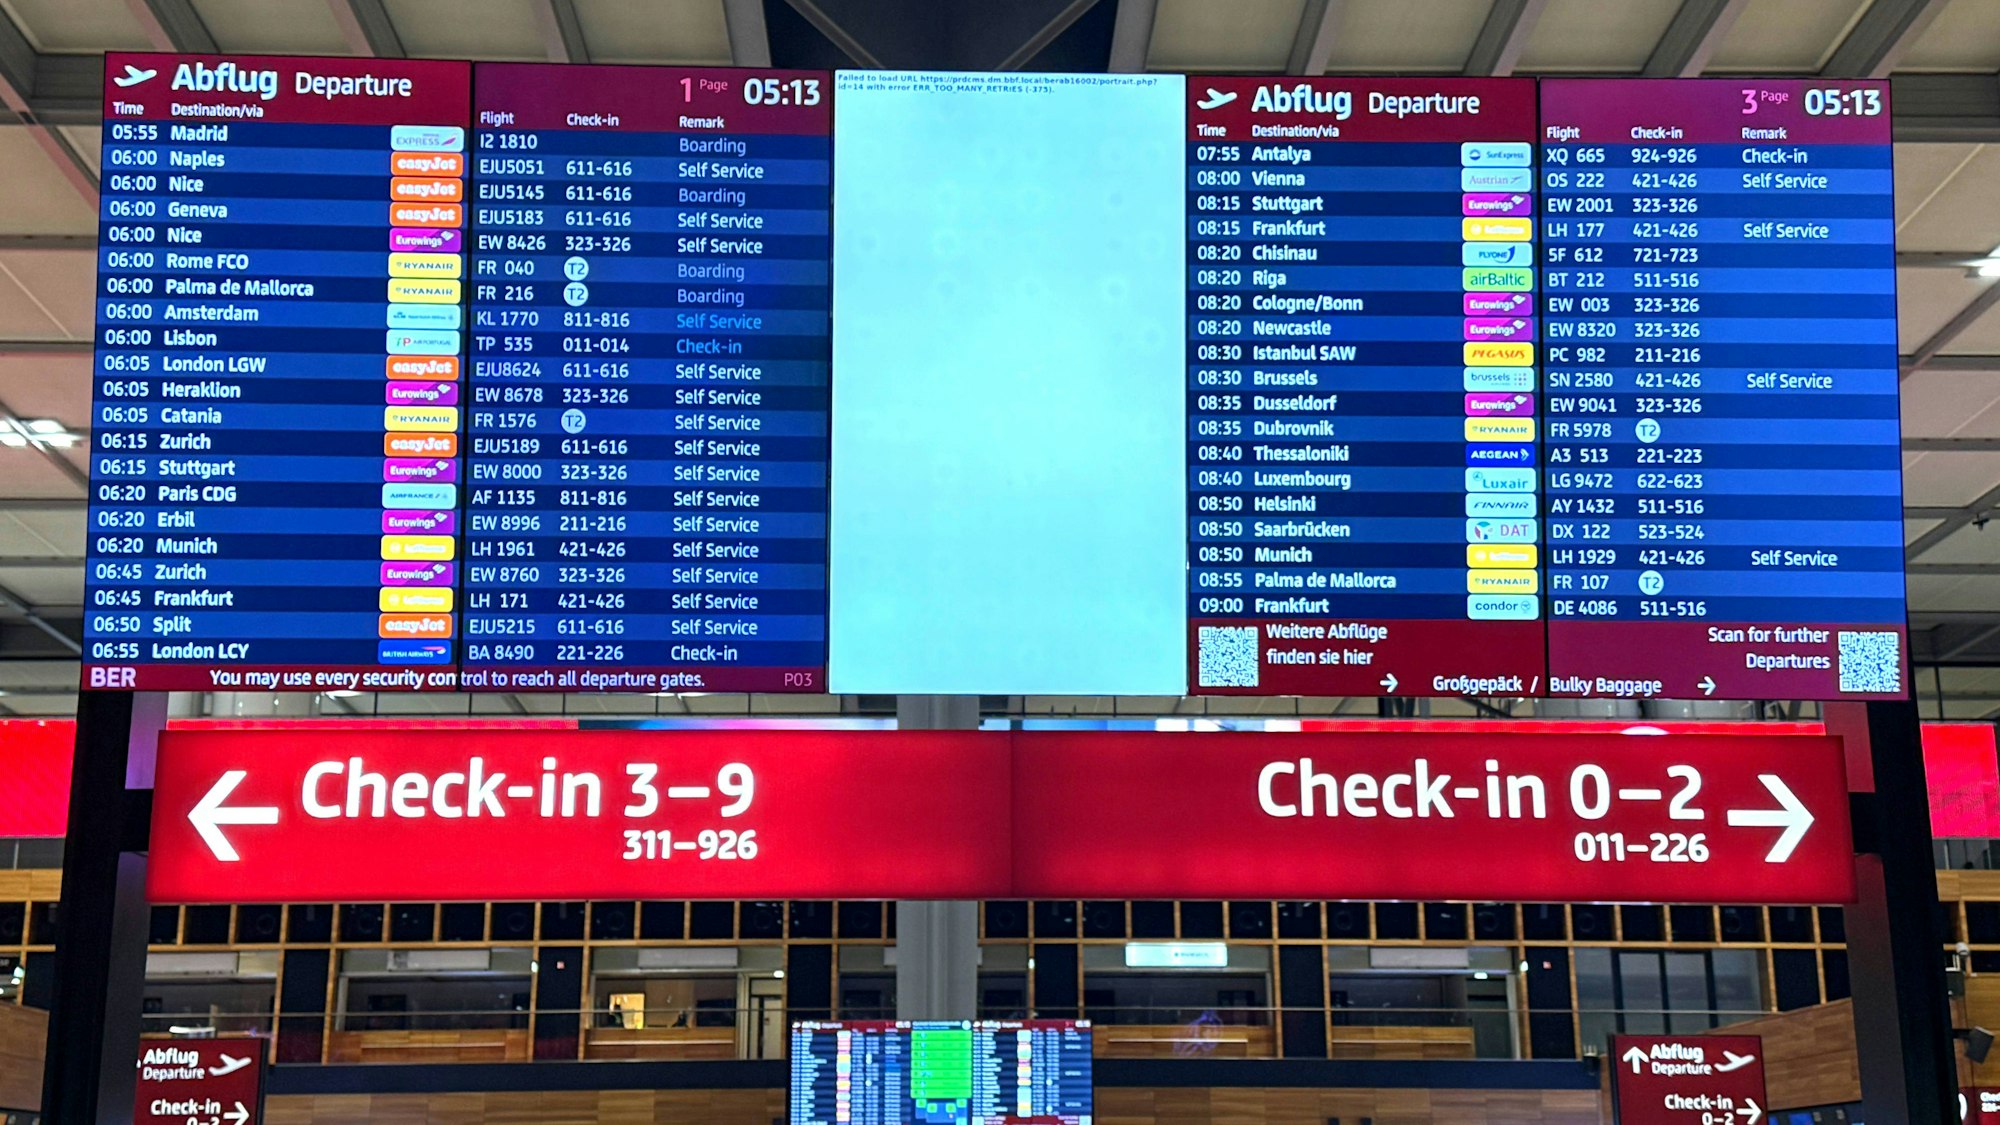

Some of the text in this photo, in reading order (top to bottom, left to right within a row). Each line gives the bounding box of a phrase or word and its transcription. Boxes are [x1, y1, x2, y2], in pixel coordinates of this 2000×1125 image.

[172, 62, 412, 100] Abflug Departure
[913, 84, 1022, 94] ERR_TOO_MANY_RETRIES
[680, 78, 820, 105] 1 Page 05:13
[113, 102, 264, 118] Time Destination/via
[1251, 84, 1480, 120] Abflug Departure
[1741, 88, 1882, 116] 3 Page 05:13
[480, 112, 724, 129] Flight Check-in Remark
[112, 124, 228, 141] 05:55 Madrid
[1196, 124, 1340, 139] Time Destination/via
[1546, 126, 1787, 141] Flight Check-in Remark
[480, 133, 745, 156] I2 1810 Boarding
[111, 149, 224, 170] 06:00 Naples
[1197, 145, 1311, 165] 07:55 Antalya
[1546, 148, 1807, 165] XQ 665 924-926 Check-in
[397, 156, 456, 172] easyJet
[480, 159, 763, 178] EJU5051 611-616 Self Service
[1197, 170, 1305, 186] 08:00 Vienna
[1470, 176, 1509, 184] Austrian
[1547, 172, 1827, 188] OS 222 421-426 Self Service
[396, 235, 443, 248] Eurowings
[108, 252, 248, 269] 06:00 Rome FCO
[404, 262, 454, 270] RYANAIR
[478, 260, 744, 281] FR 040 T2 Boarding
[1470, 273, 1525, 286] airBaltic
[1198, 344, 1356, 360] 08:30 Istanbul SAW
[1472, 349, 1525, 359] PEGASUS
[1550, 347, 1700, 362] PC 982 211-216
[1471, 372, 1510, 381] brussels
[1198, 444, 1349, 461] 08:40 Thessaloniki
[1471, 450, 1518, 459] AEGEAN
[1550, 448, 1702, 463] A3 513 221-223
[1482, 478, 1528, 489] Luxair
[99, 484, 236, 502] 06:20 Paris CDG
[472, 489, 759, 507] AF 1135 811-816 Self Service
[1500, 524, 1529, 537] DAT
[1199, 597, 1329, 613] 09:00 Frankfurt
[1475, 601, 1518, 611] condor
[1554, 600, 1706, 615] DE 4086 511-516
[1266, 623, 1388, 643] Weitere Abflüge
[1708, 627, 1829, 643] Scan for further
[92, 642, 249, 658] 06:55 London LCY
[468, 644, 737, 660] BA 8490 221-226 Check-in
[1266, 648, 1374, 664] finden sie hier
[1746, 654, 1831, 672] Departures
[90, 667, 136, 687] BER
[210, 670, 241, 686] You
[245, 673, 280, 689] may
[283, 673, 312, 686] use
[315, 673, 360, 689] every
[362, 670, 425, 689] security
[491, 672, 508, 686] to
[512, 670, 554, 686] reach
[558, 670, 576, 686] all
[580, 670, 657, 689] departure
[660, 672, 705, 689] gates.
[784, 673, 812, 687] P03
[1433, 676, 1522, 695] Großgepäck
[1550, 678, 1662, 696] Bulky Baggage
[302, 756, 756, 819] Check-in 3–9
[1258, 758, 1705, 821] Check-in 0–2
[622, 828, 759, 862] 311–926
[1574, 832, 1710, 864] 011–226
[143, 1047, 199, 1068] Abflug
[1650, 1043, 1704, 1063] Abflug
[142, 1066, 205, 1082] Departure
[1651, 1062, 1713, 1077] Departure
[151, 1098, 221, 1115] Check-in
[1664, 1094, 1734, 1110] Check-in
